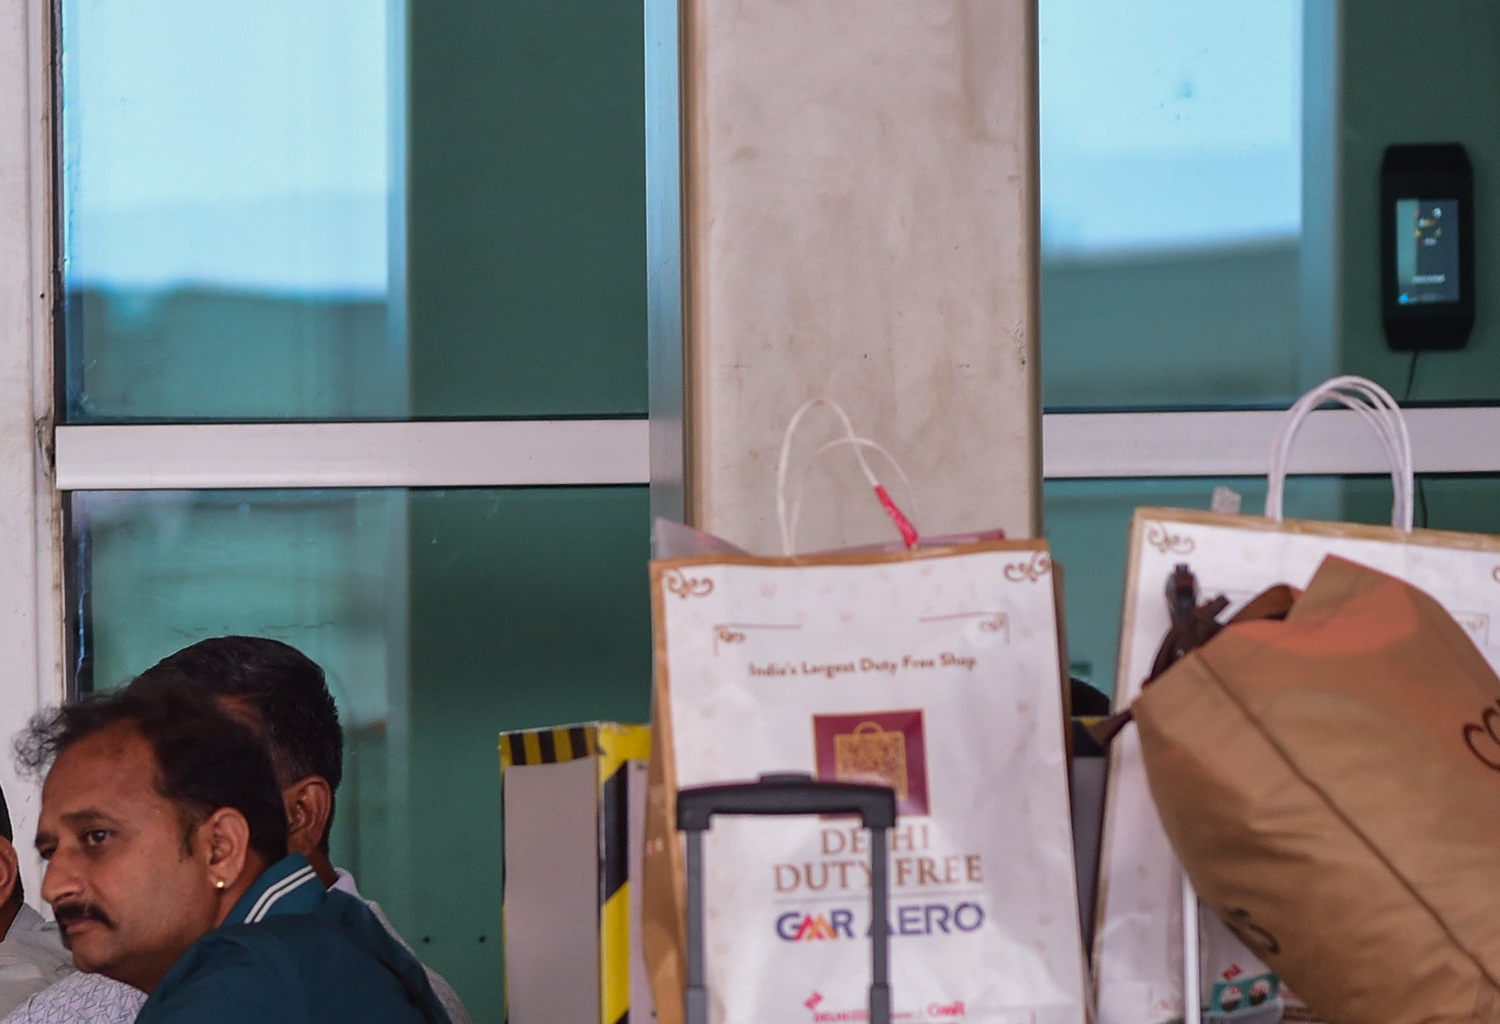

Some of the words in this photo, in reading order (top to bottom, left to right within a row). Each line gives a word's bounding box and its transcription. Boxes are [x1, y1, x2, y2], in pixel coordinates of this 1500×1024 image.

[749, 660, 798, 677] India's
[801, 660, 855, 679] Largest
[859, 656, 899, 676] Duty
[902, 653, 936, 669] Free
[939, 651, 977, 671] Shop
[821, 825, 931, 856] DEHI
[894, 853, 984, 887] FREE
[775, 909, 855, 942] GMR
